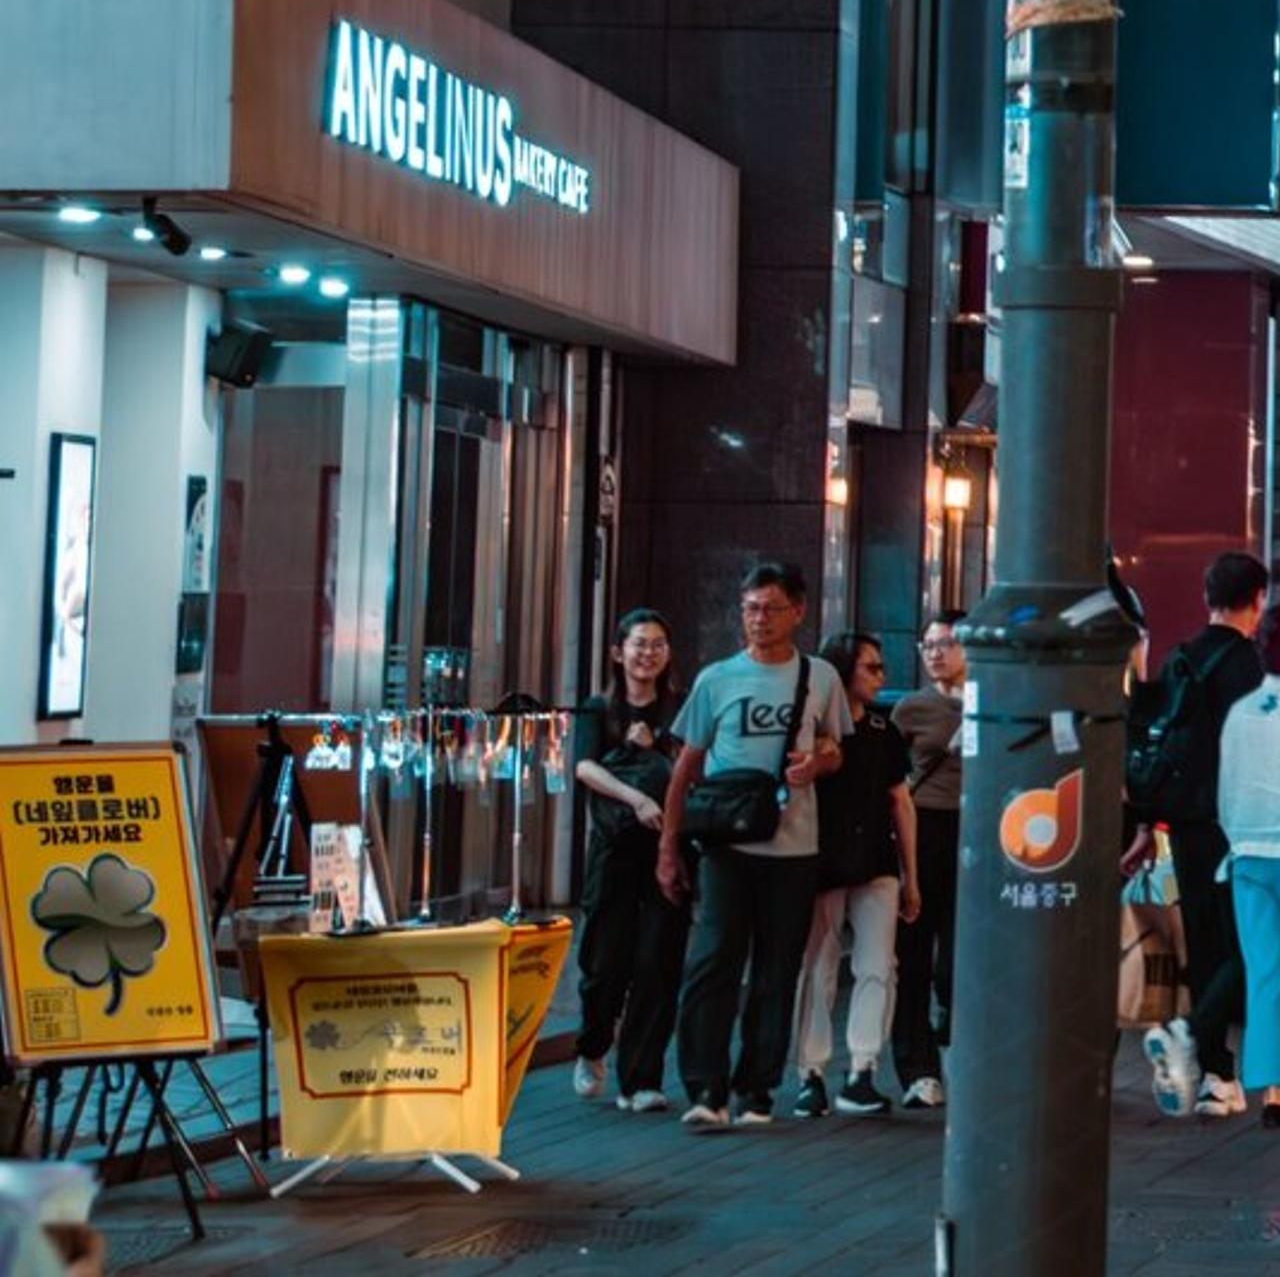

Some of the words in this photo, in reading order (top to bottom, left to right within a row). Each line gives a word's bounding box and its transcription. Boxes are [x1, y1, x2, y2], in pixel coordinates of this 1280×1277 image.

[330, 19, 513, 207] ANGELINUS
[513, 134, 555, 197] BAKERY
[558, 157, 589, 213] CAFE
[1000, 881, 1079, 910] 서울중구
